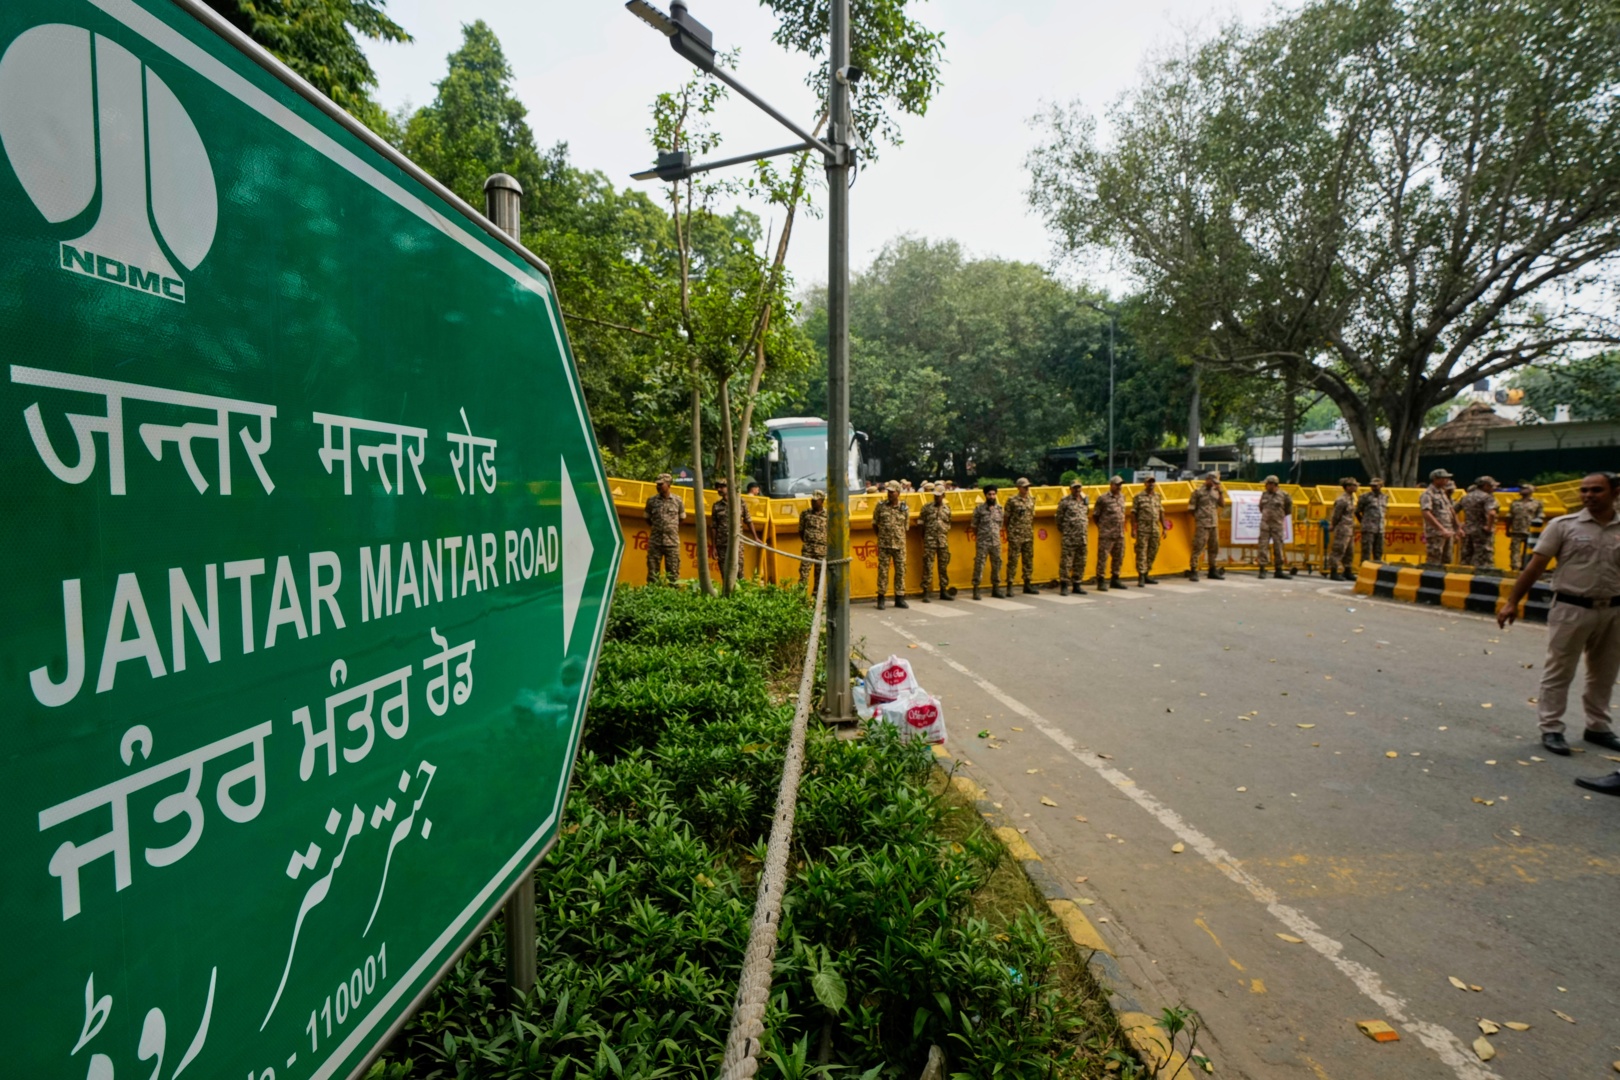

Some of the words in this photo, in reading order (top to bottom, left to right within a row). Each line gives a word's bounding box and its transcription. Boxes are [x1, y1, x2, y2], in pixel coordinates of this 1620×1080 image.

[61, 243, 184, 302] NDMC
[10, 364, 278, 497] जन्तर
[312, 411, 428, 497] मन्तर
[446, 406, 498, 496] रोड
[29, 550, 347, 707] JANTAR
[359, 532, 500, 623] MANTAR
[504, 525, 559, 584] ROAD
[853, 540, 879, 562] पुलि
[38, 719, 273, 922] ਜੰਤਰ
[292, 658, 413, 782] ਮੰਤਰ
[422, 626, 476, 717] ਰੋਡ
[362, 759, 438, 938] جنتر
[259, 803, 366, 1033] منتر
[306, 942, 387, 1054] 110001
